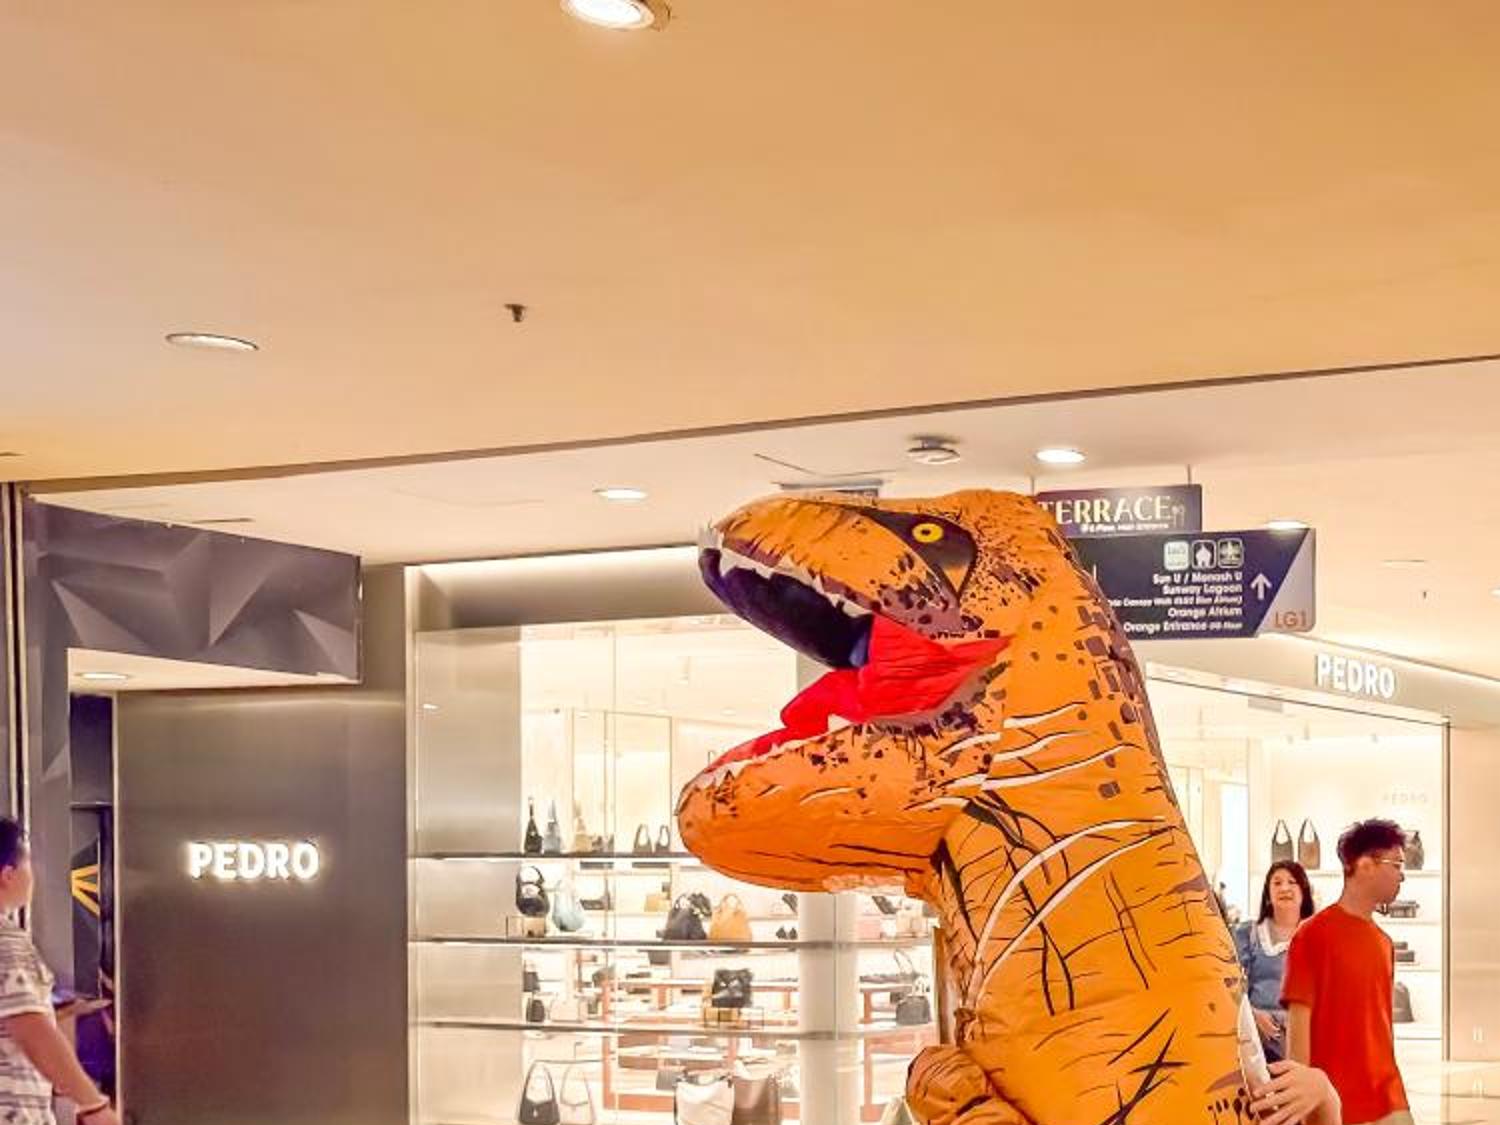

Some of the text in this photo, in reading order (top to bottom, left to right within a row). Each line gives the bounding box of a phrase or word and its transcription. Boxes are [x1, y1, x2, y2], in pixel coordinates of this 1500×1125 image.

[1162, 583, 1243, 596] Sunway Lagoon
[1167, 607, 1243, 619] Orange Atrium
[1274, 610, 1307, 629] LG1
[1123, 621, 1161, 634] Orange
[1162, 621, 1207, 631] Entrance
[1315, 652, 1396, 698] PEDRO
[189, 840, 319, 879] PEDRO
